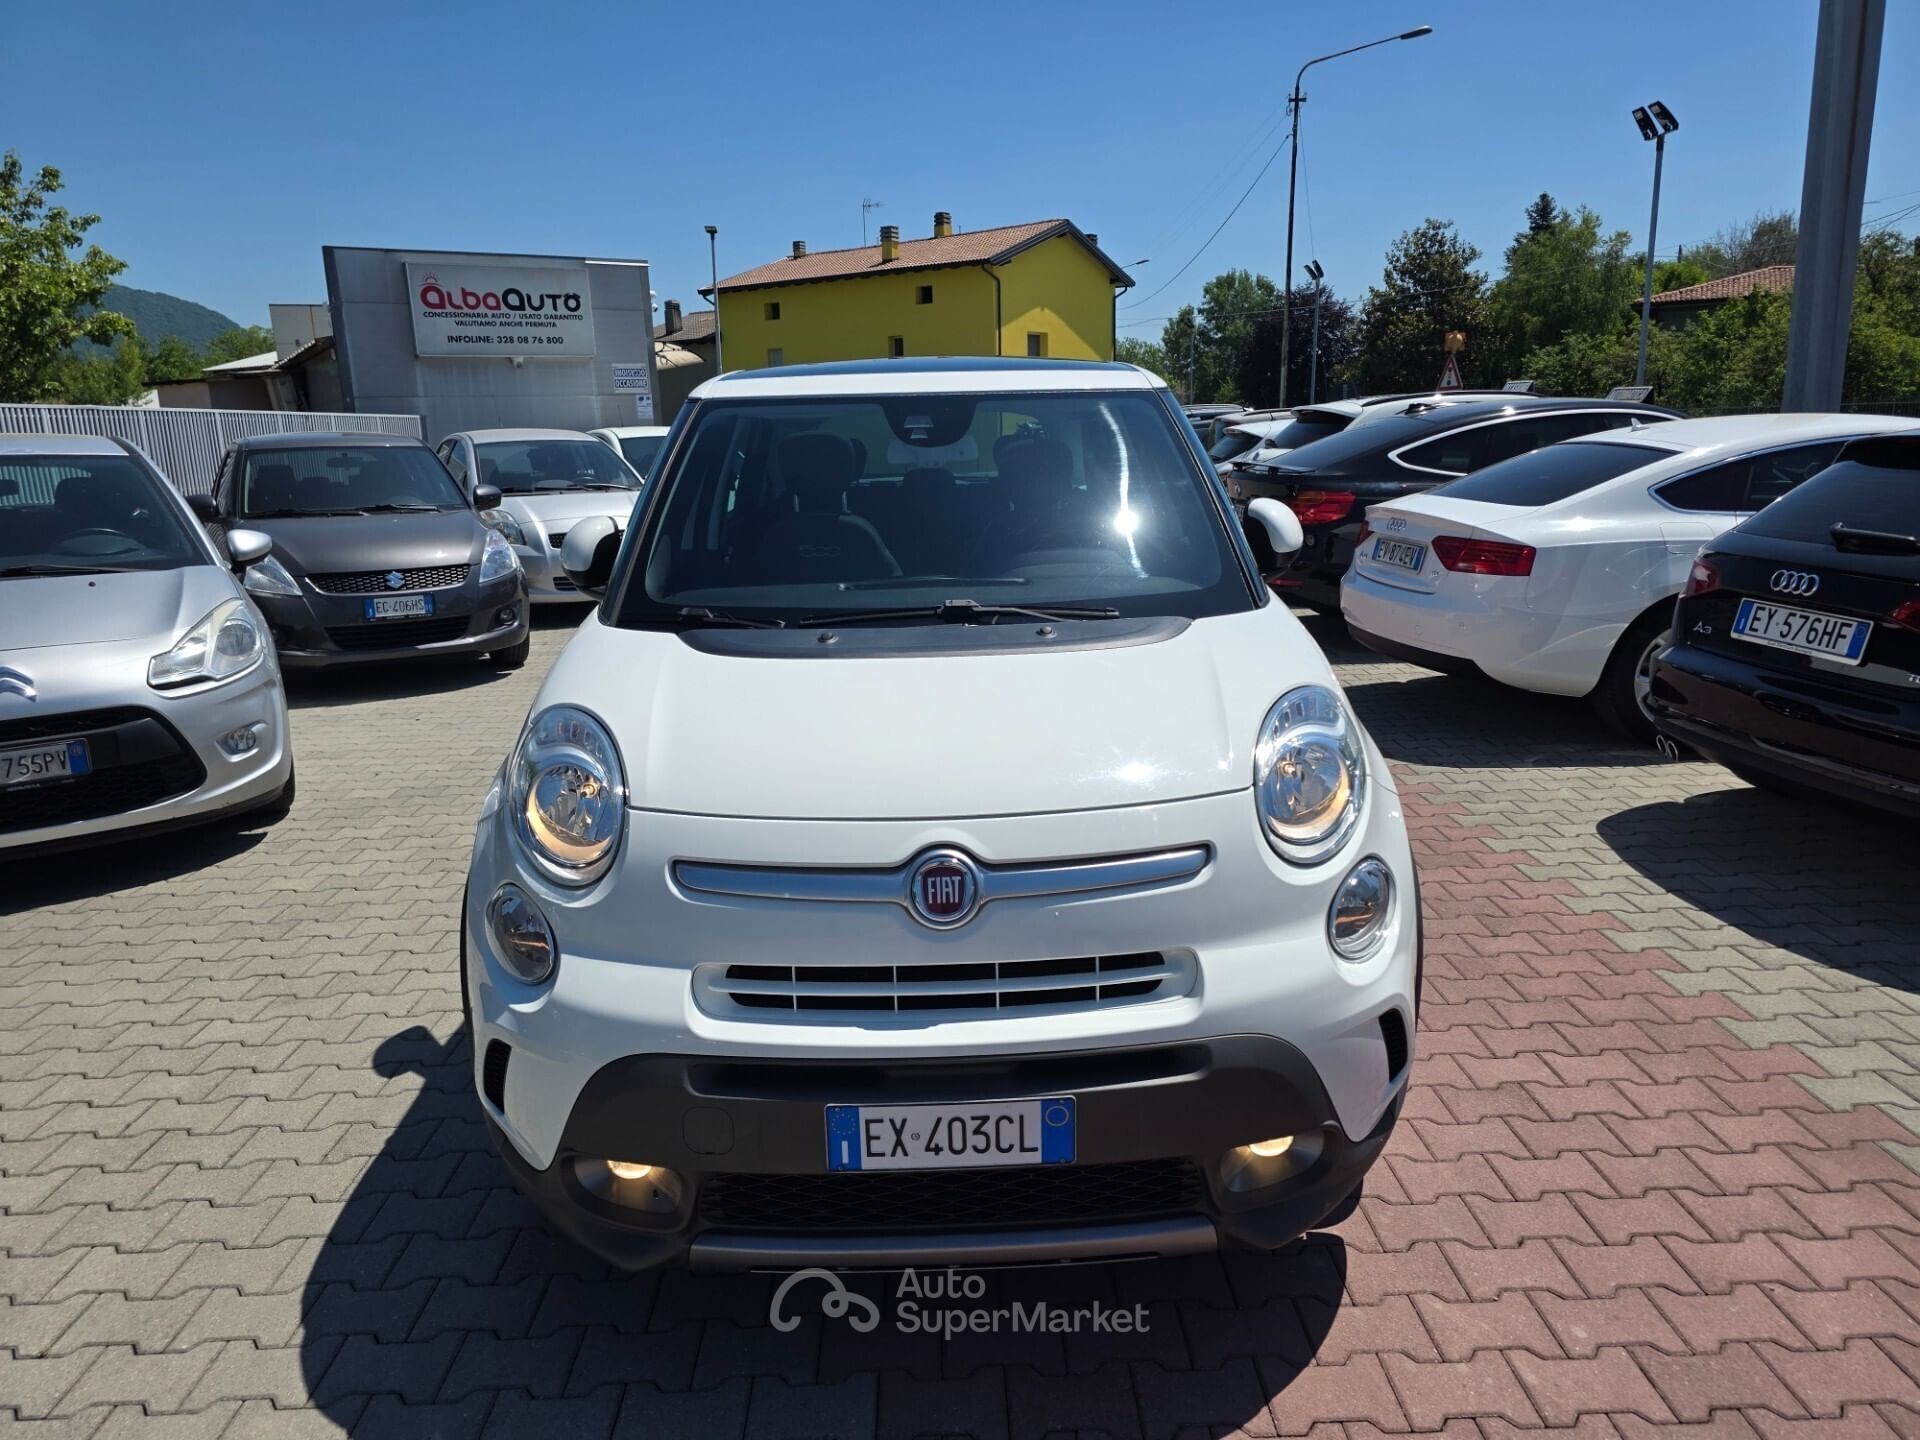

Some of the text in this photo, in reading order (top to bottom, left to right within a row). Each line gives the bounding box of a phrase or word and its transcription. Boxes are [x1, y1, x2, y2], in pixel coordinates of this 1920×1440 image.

[423, 311, 489, 319] CONCESSIONARIA
[454, 319, 497, 327] VALUTIAMO
[499, 320, 523, 328] ANCHE
[447, 335, 564, 344] INFOLINE: 328 08 76 800
[1693, 621, 1713, 635] A3
[1749, 606, 1779, 635] EY
[1779, 612, 1853, 650] 576HF
[2, 750, 67, 778] 755PV
[927, 876, 962, 905] FIAT
[864, 1117, 910, 1158] EX
[924, 1114, 1039, 1157] 403CL
